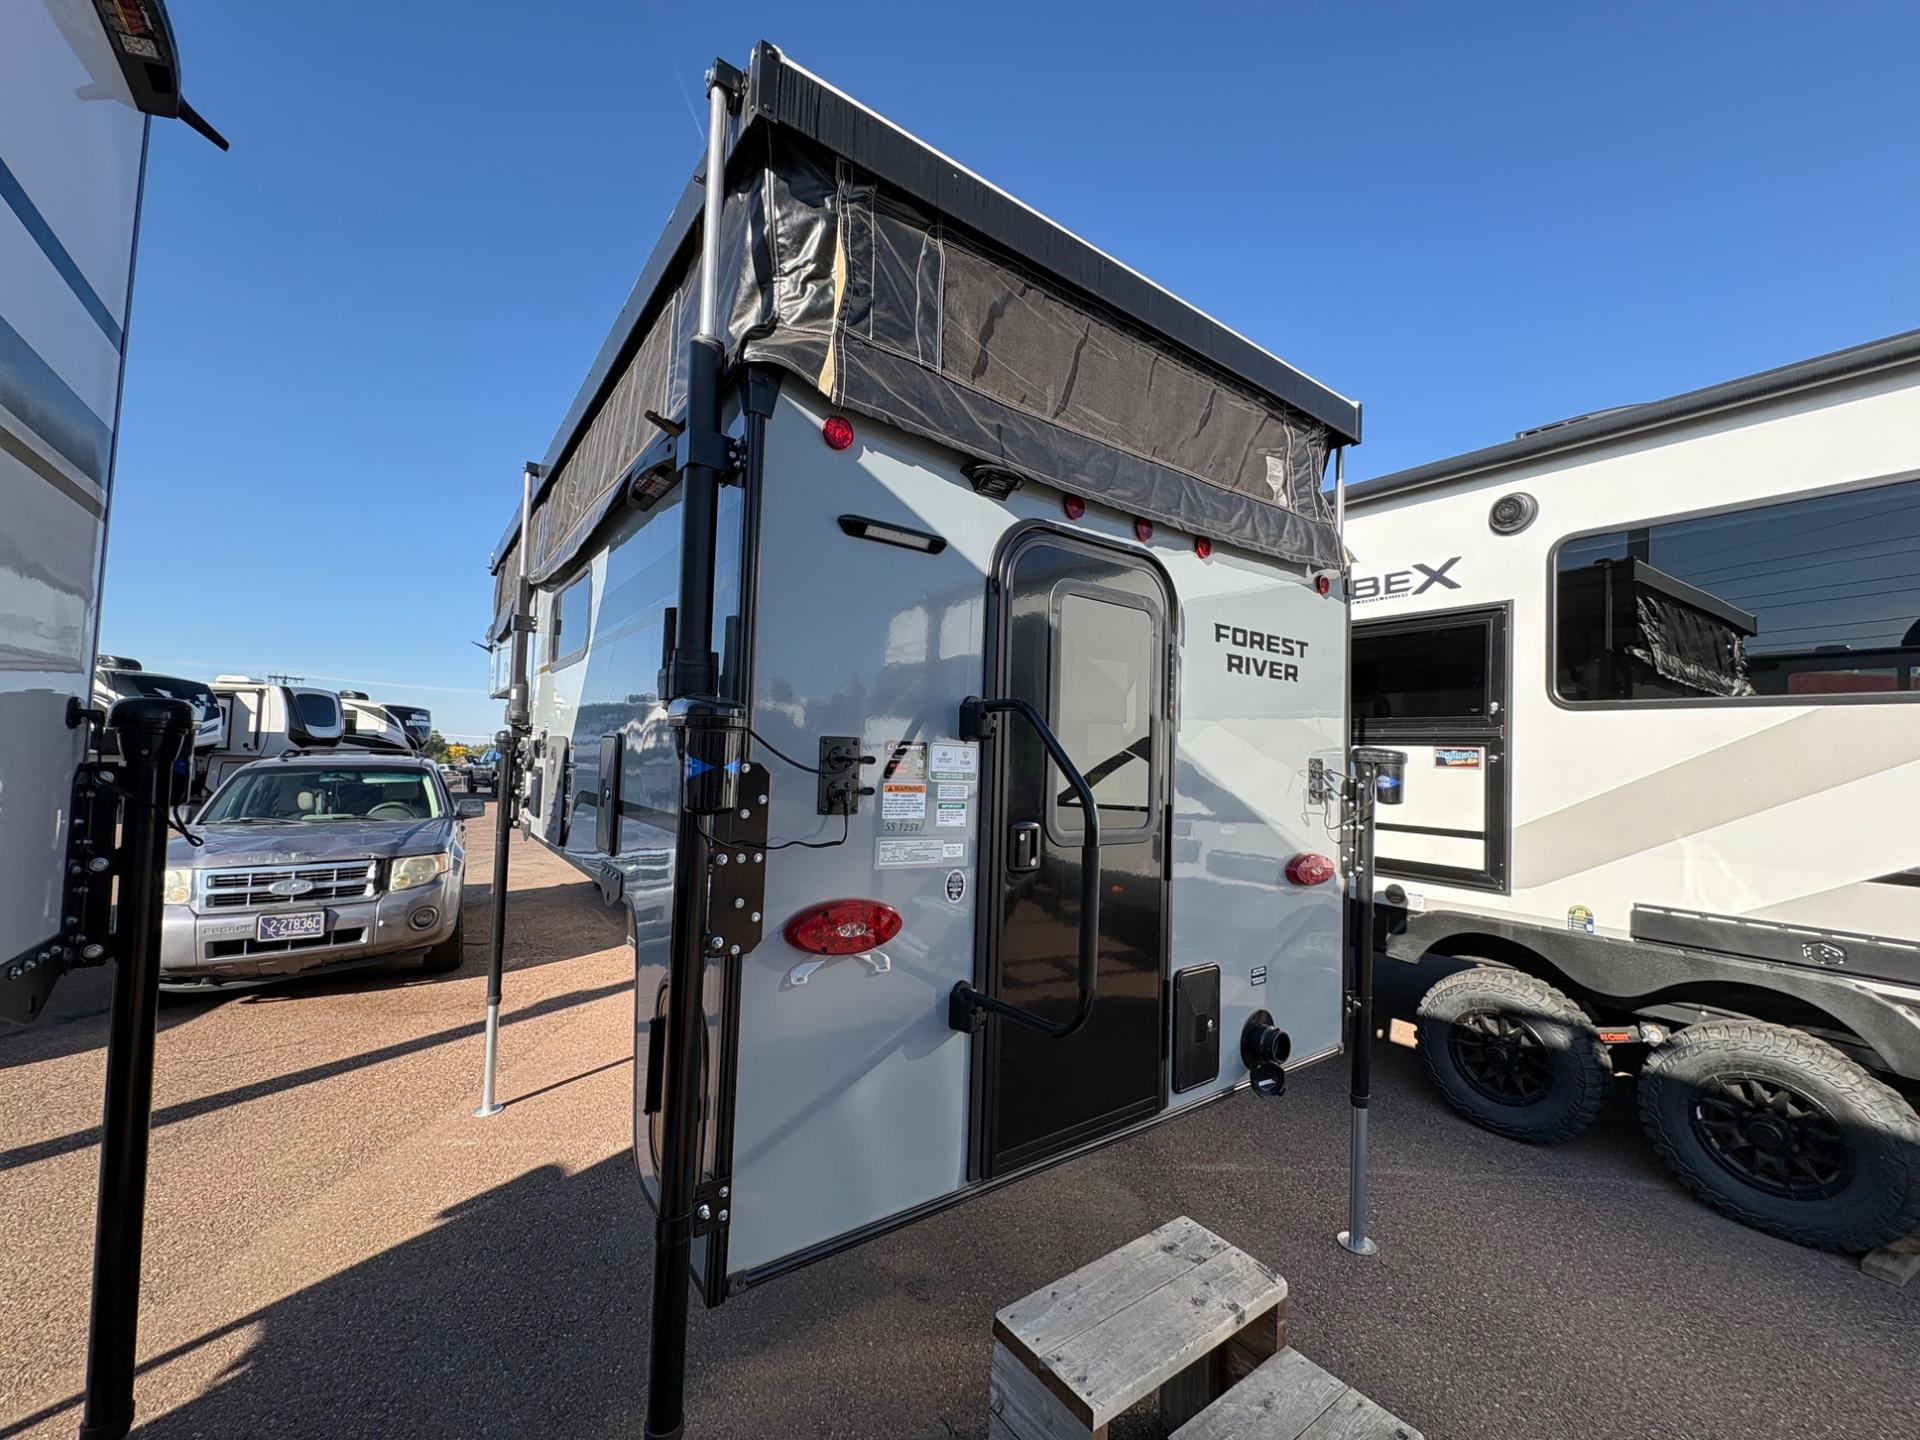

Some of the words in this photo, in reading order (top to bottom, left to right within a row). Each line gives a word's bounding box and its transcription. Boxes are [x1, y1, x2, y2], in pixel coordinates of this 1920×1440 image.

[1351, 555, 1462, 600] BEX
[1214, 622, 1309, 658] FOREST
[1226, 653, 1299, 683] RIVER
